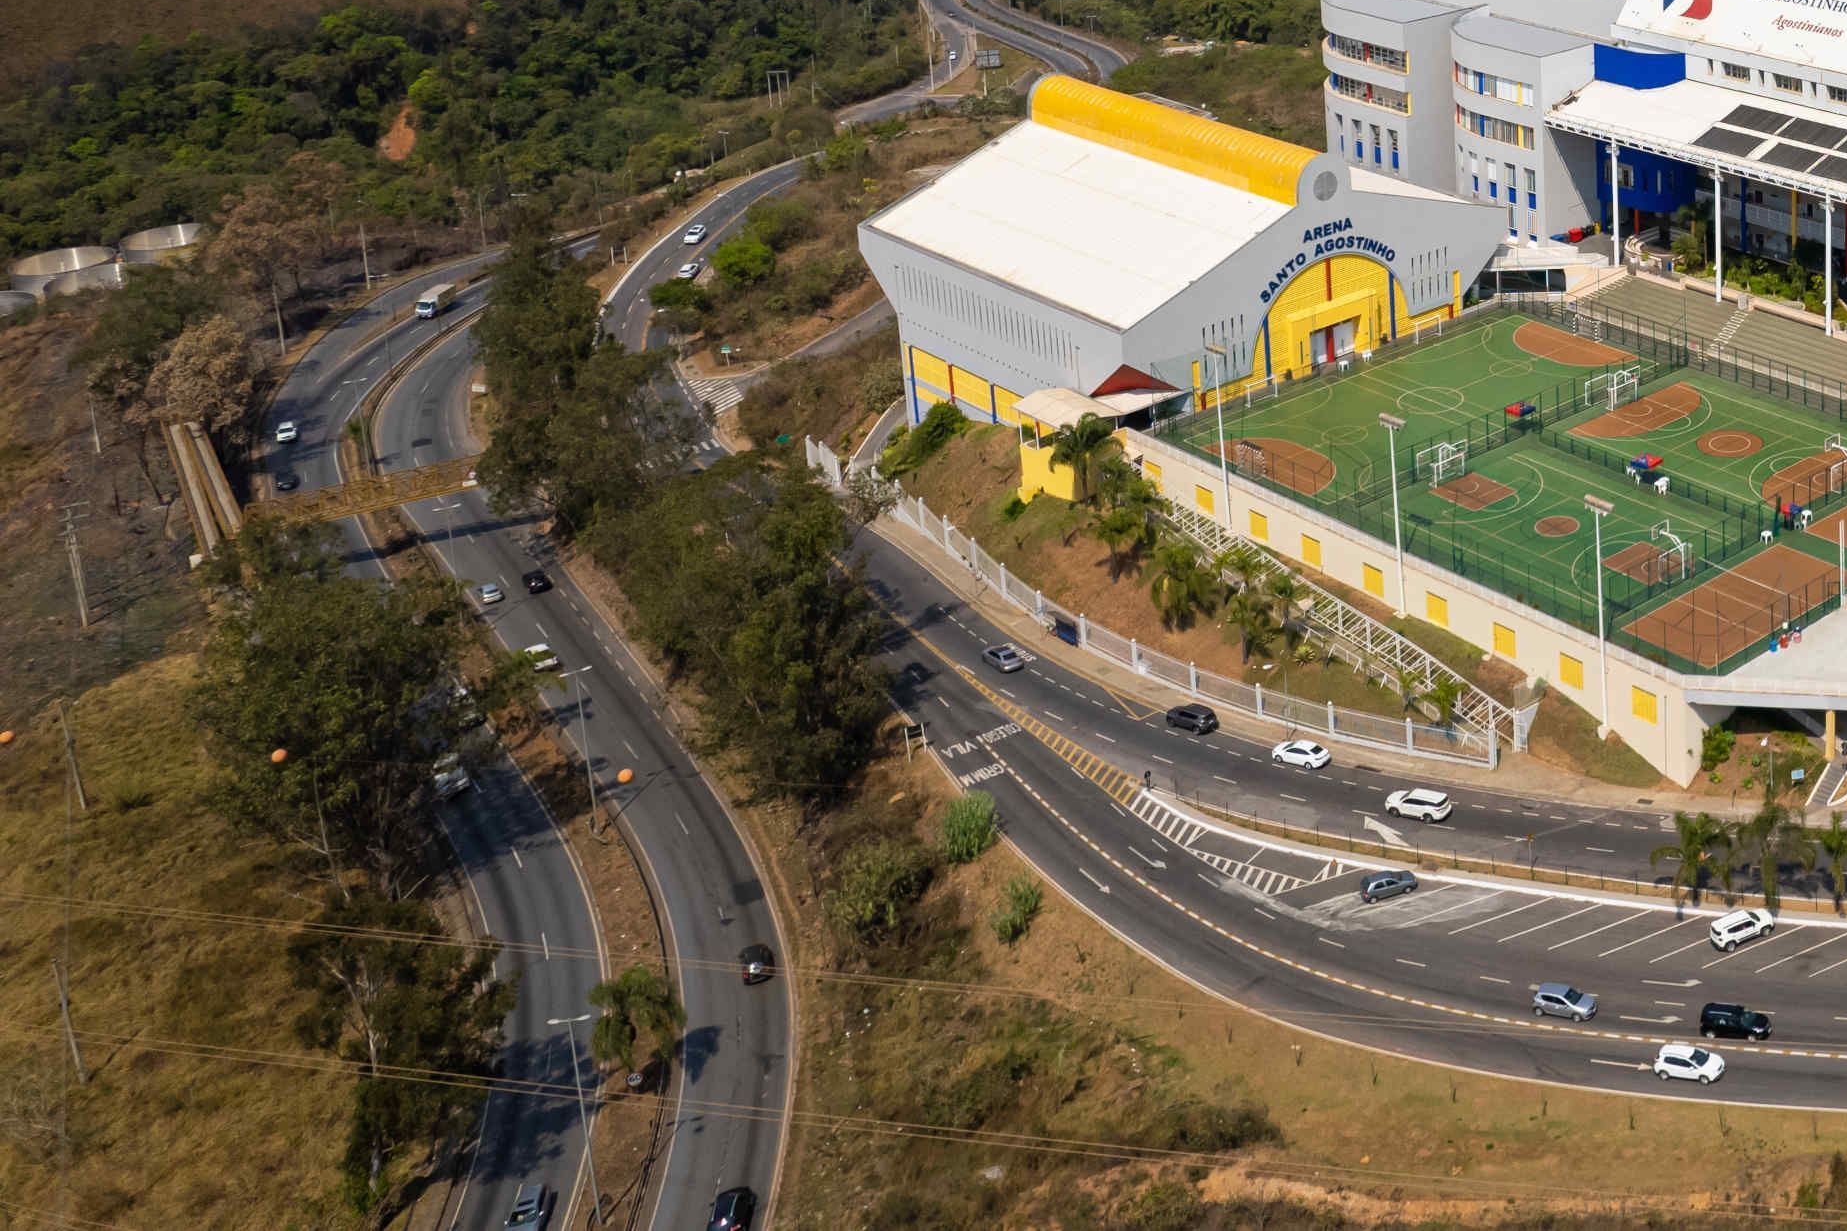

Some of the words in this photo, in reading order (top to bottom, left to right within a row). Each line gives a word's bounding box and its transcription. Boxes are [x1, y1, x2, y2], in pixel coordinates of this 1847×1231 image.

[1771, 15, 1844, 37] Agostinianos
[1303, 218, 1353, 243] ARENA
[1260, 253, 1306, 303] SANTO
[1314, 236, 1396, 262] AGOSTINHO
[941, 741, 978, 758] VILA
